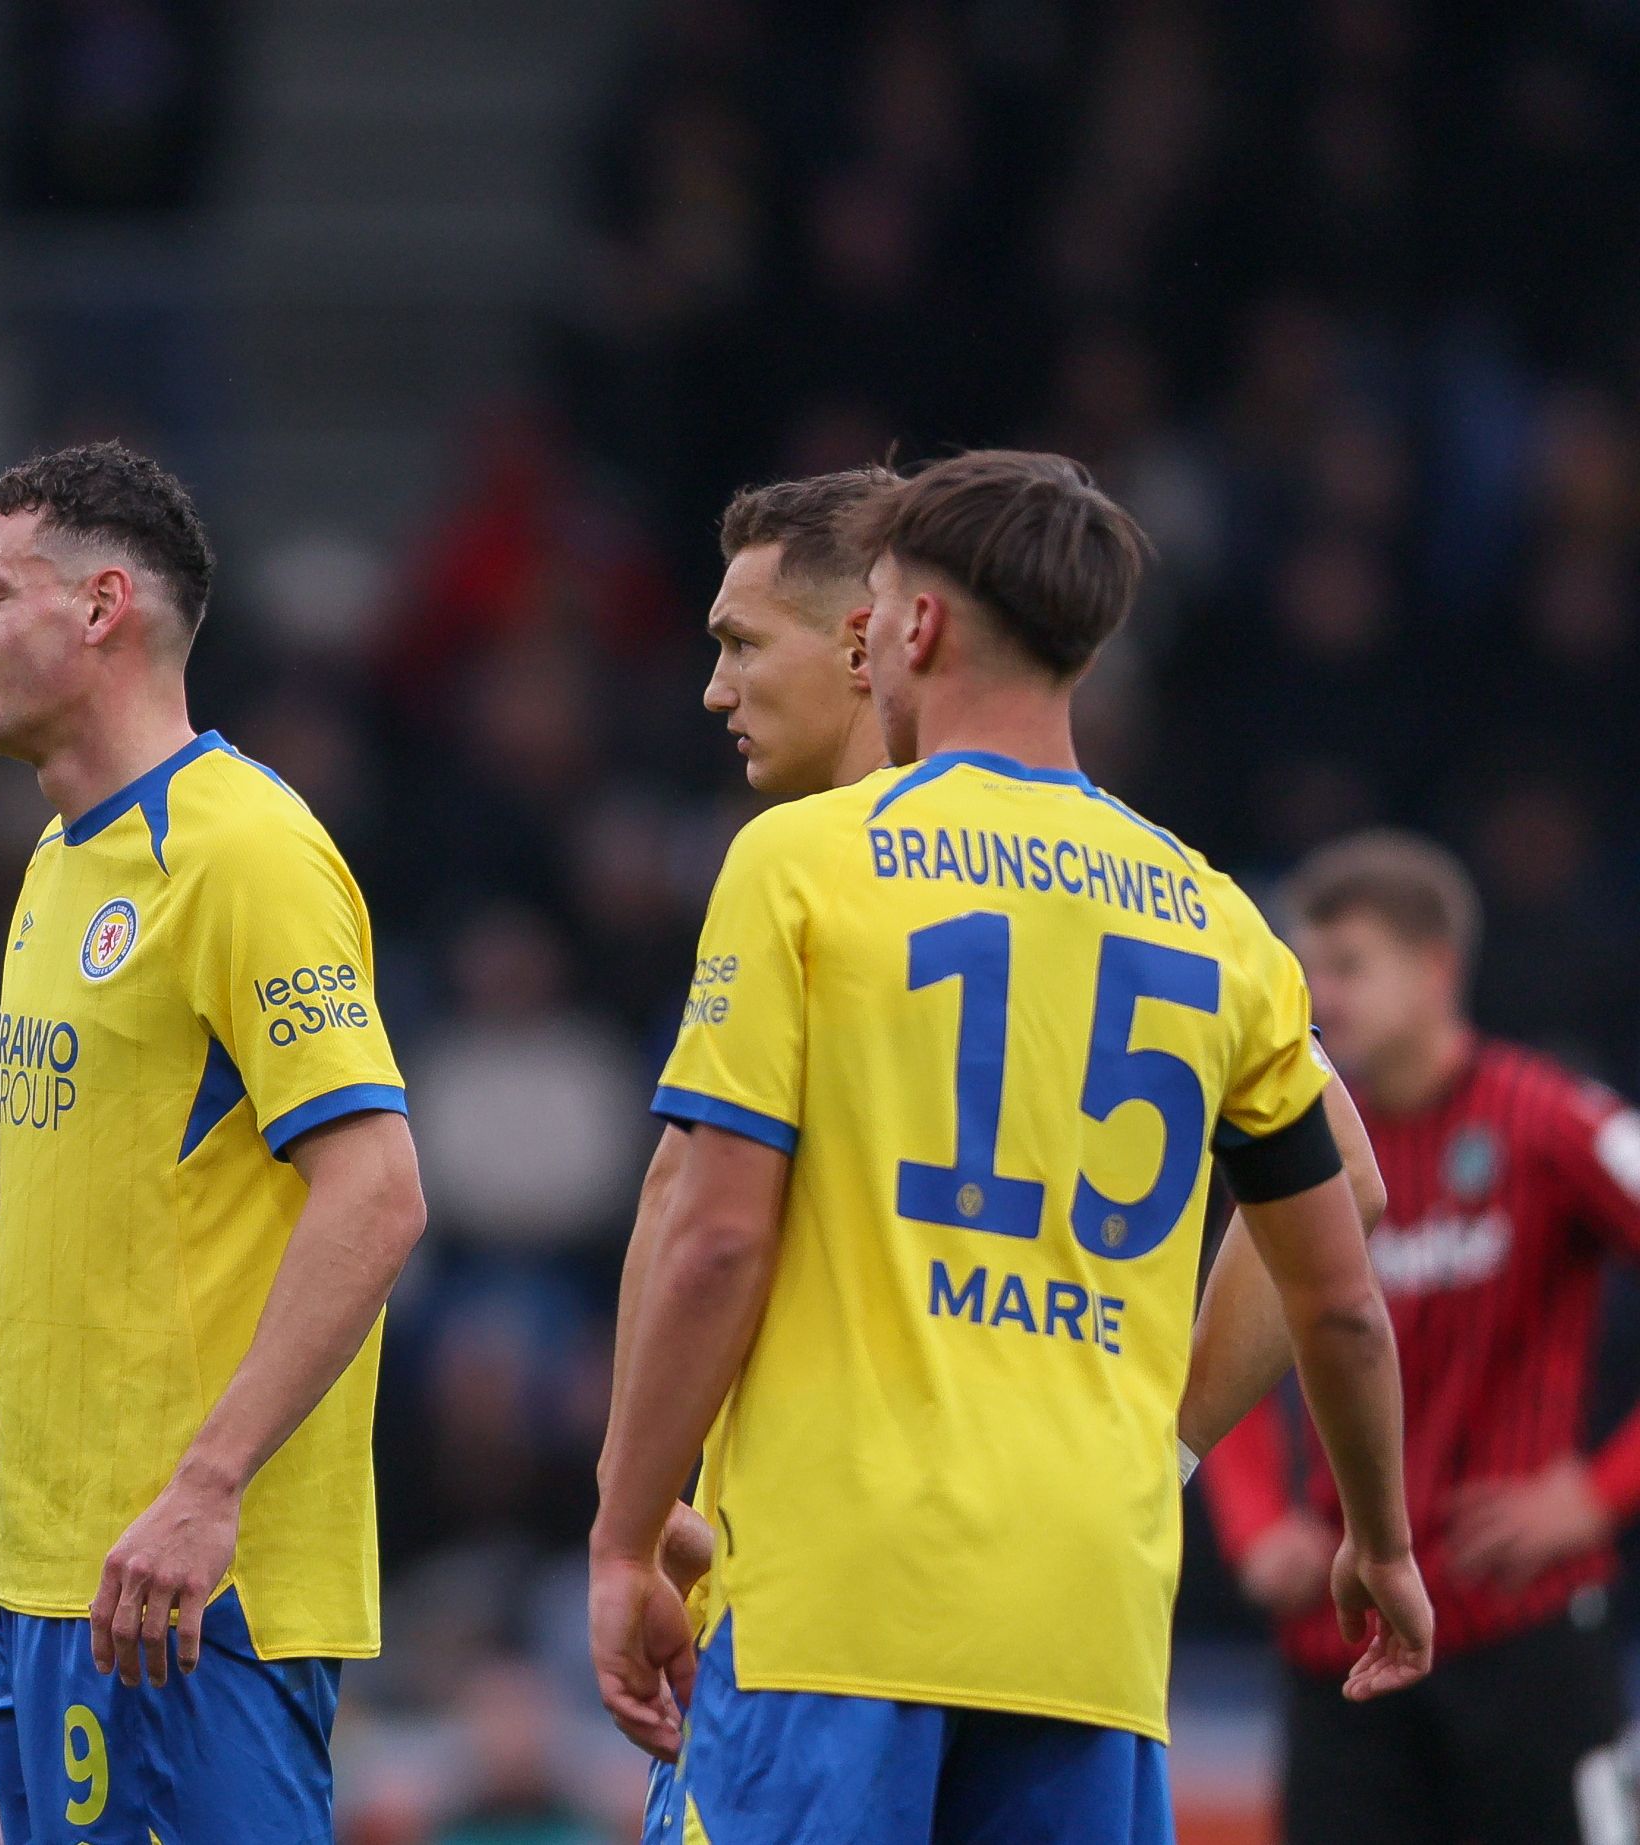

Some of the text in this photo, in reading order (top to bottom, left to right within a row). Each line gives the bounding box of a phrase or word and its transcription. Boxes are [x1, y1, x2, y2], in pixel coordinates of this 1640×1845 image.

[868, 827, 1210, 931] BRAUNSCHWEIG
[253, 964, 357, 1013] lease
[692, 954, 738, 986] ase
[0, 1013, 79, 1073] RAWO
[0, 1068, 76, 1131] ROUP
[896, 910, 1221, 1261] 15
[929, 1259, 1125, 1355] MARE
[64, 1704, 109, 1826] 9
